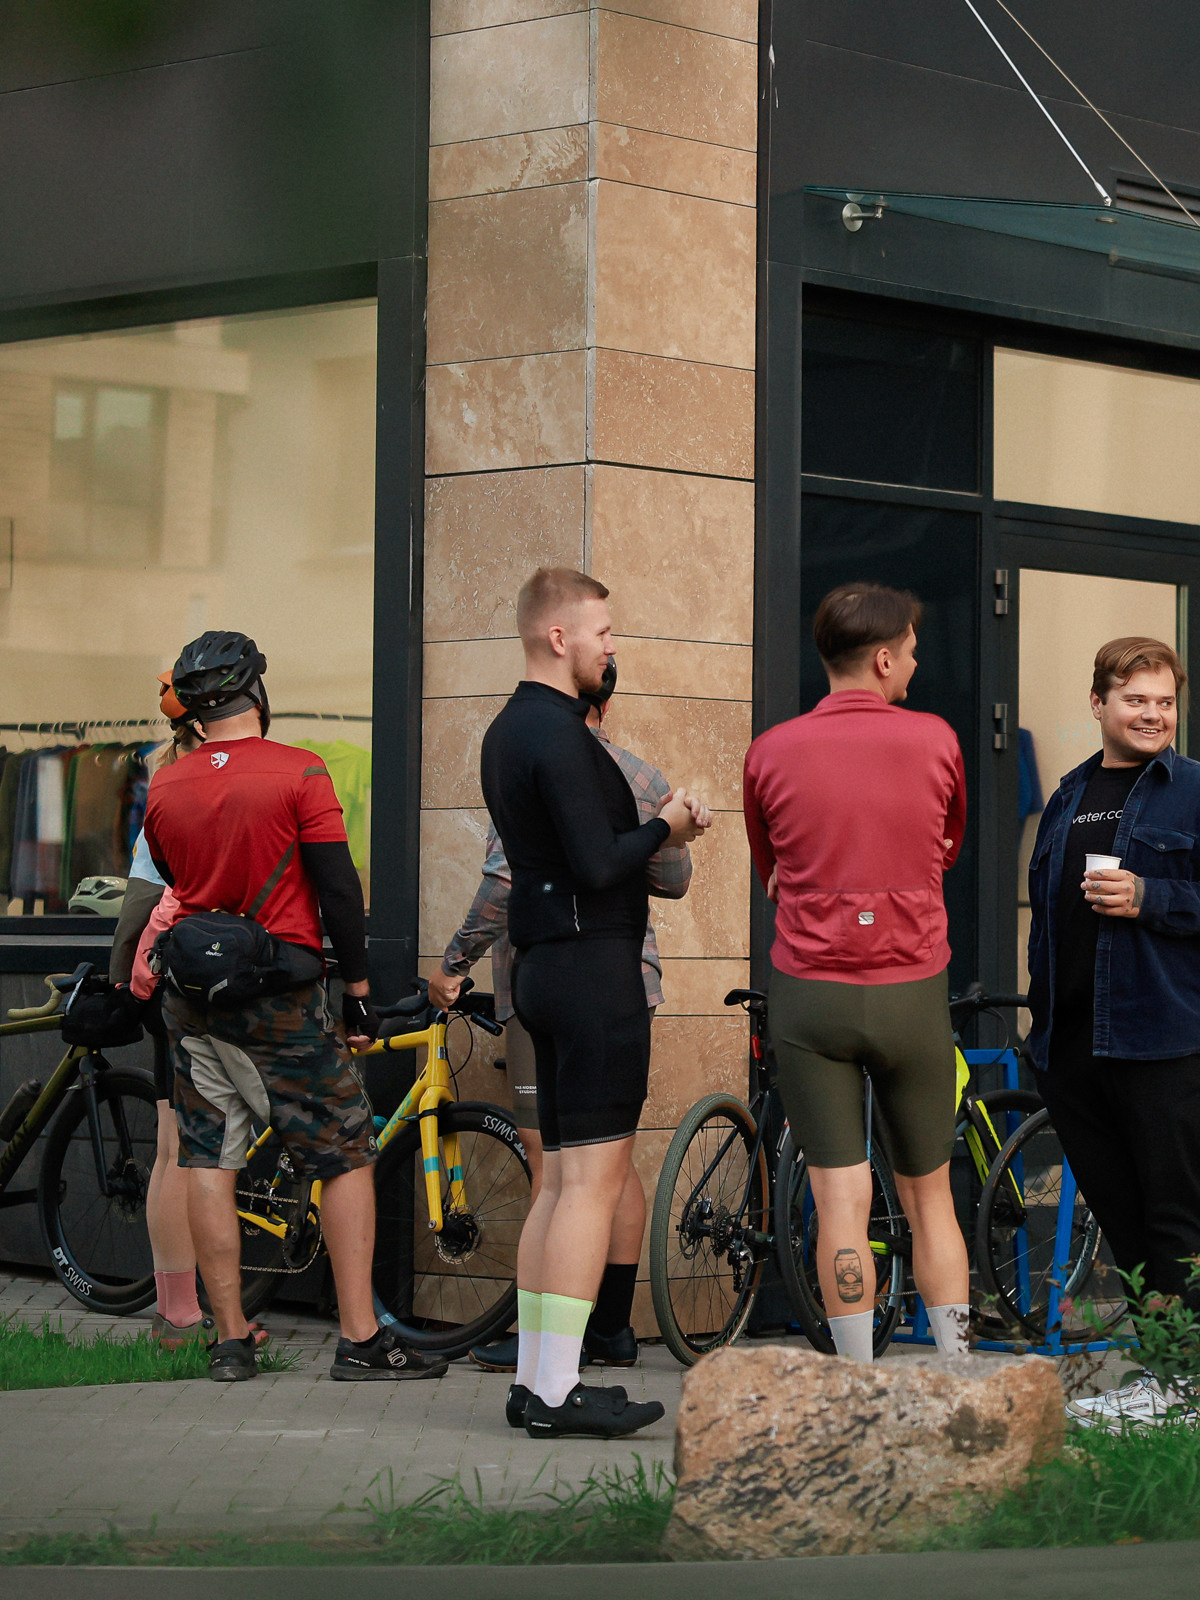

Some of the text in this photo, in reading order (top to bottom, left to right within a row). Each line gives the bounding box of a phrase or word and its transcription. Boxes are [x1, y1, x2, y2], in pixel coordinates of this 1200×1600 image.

[482, 1115, 518, 1142] SWISS
[53, 1246, 93, 1296] DT SWISS
